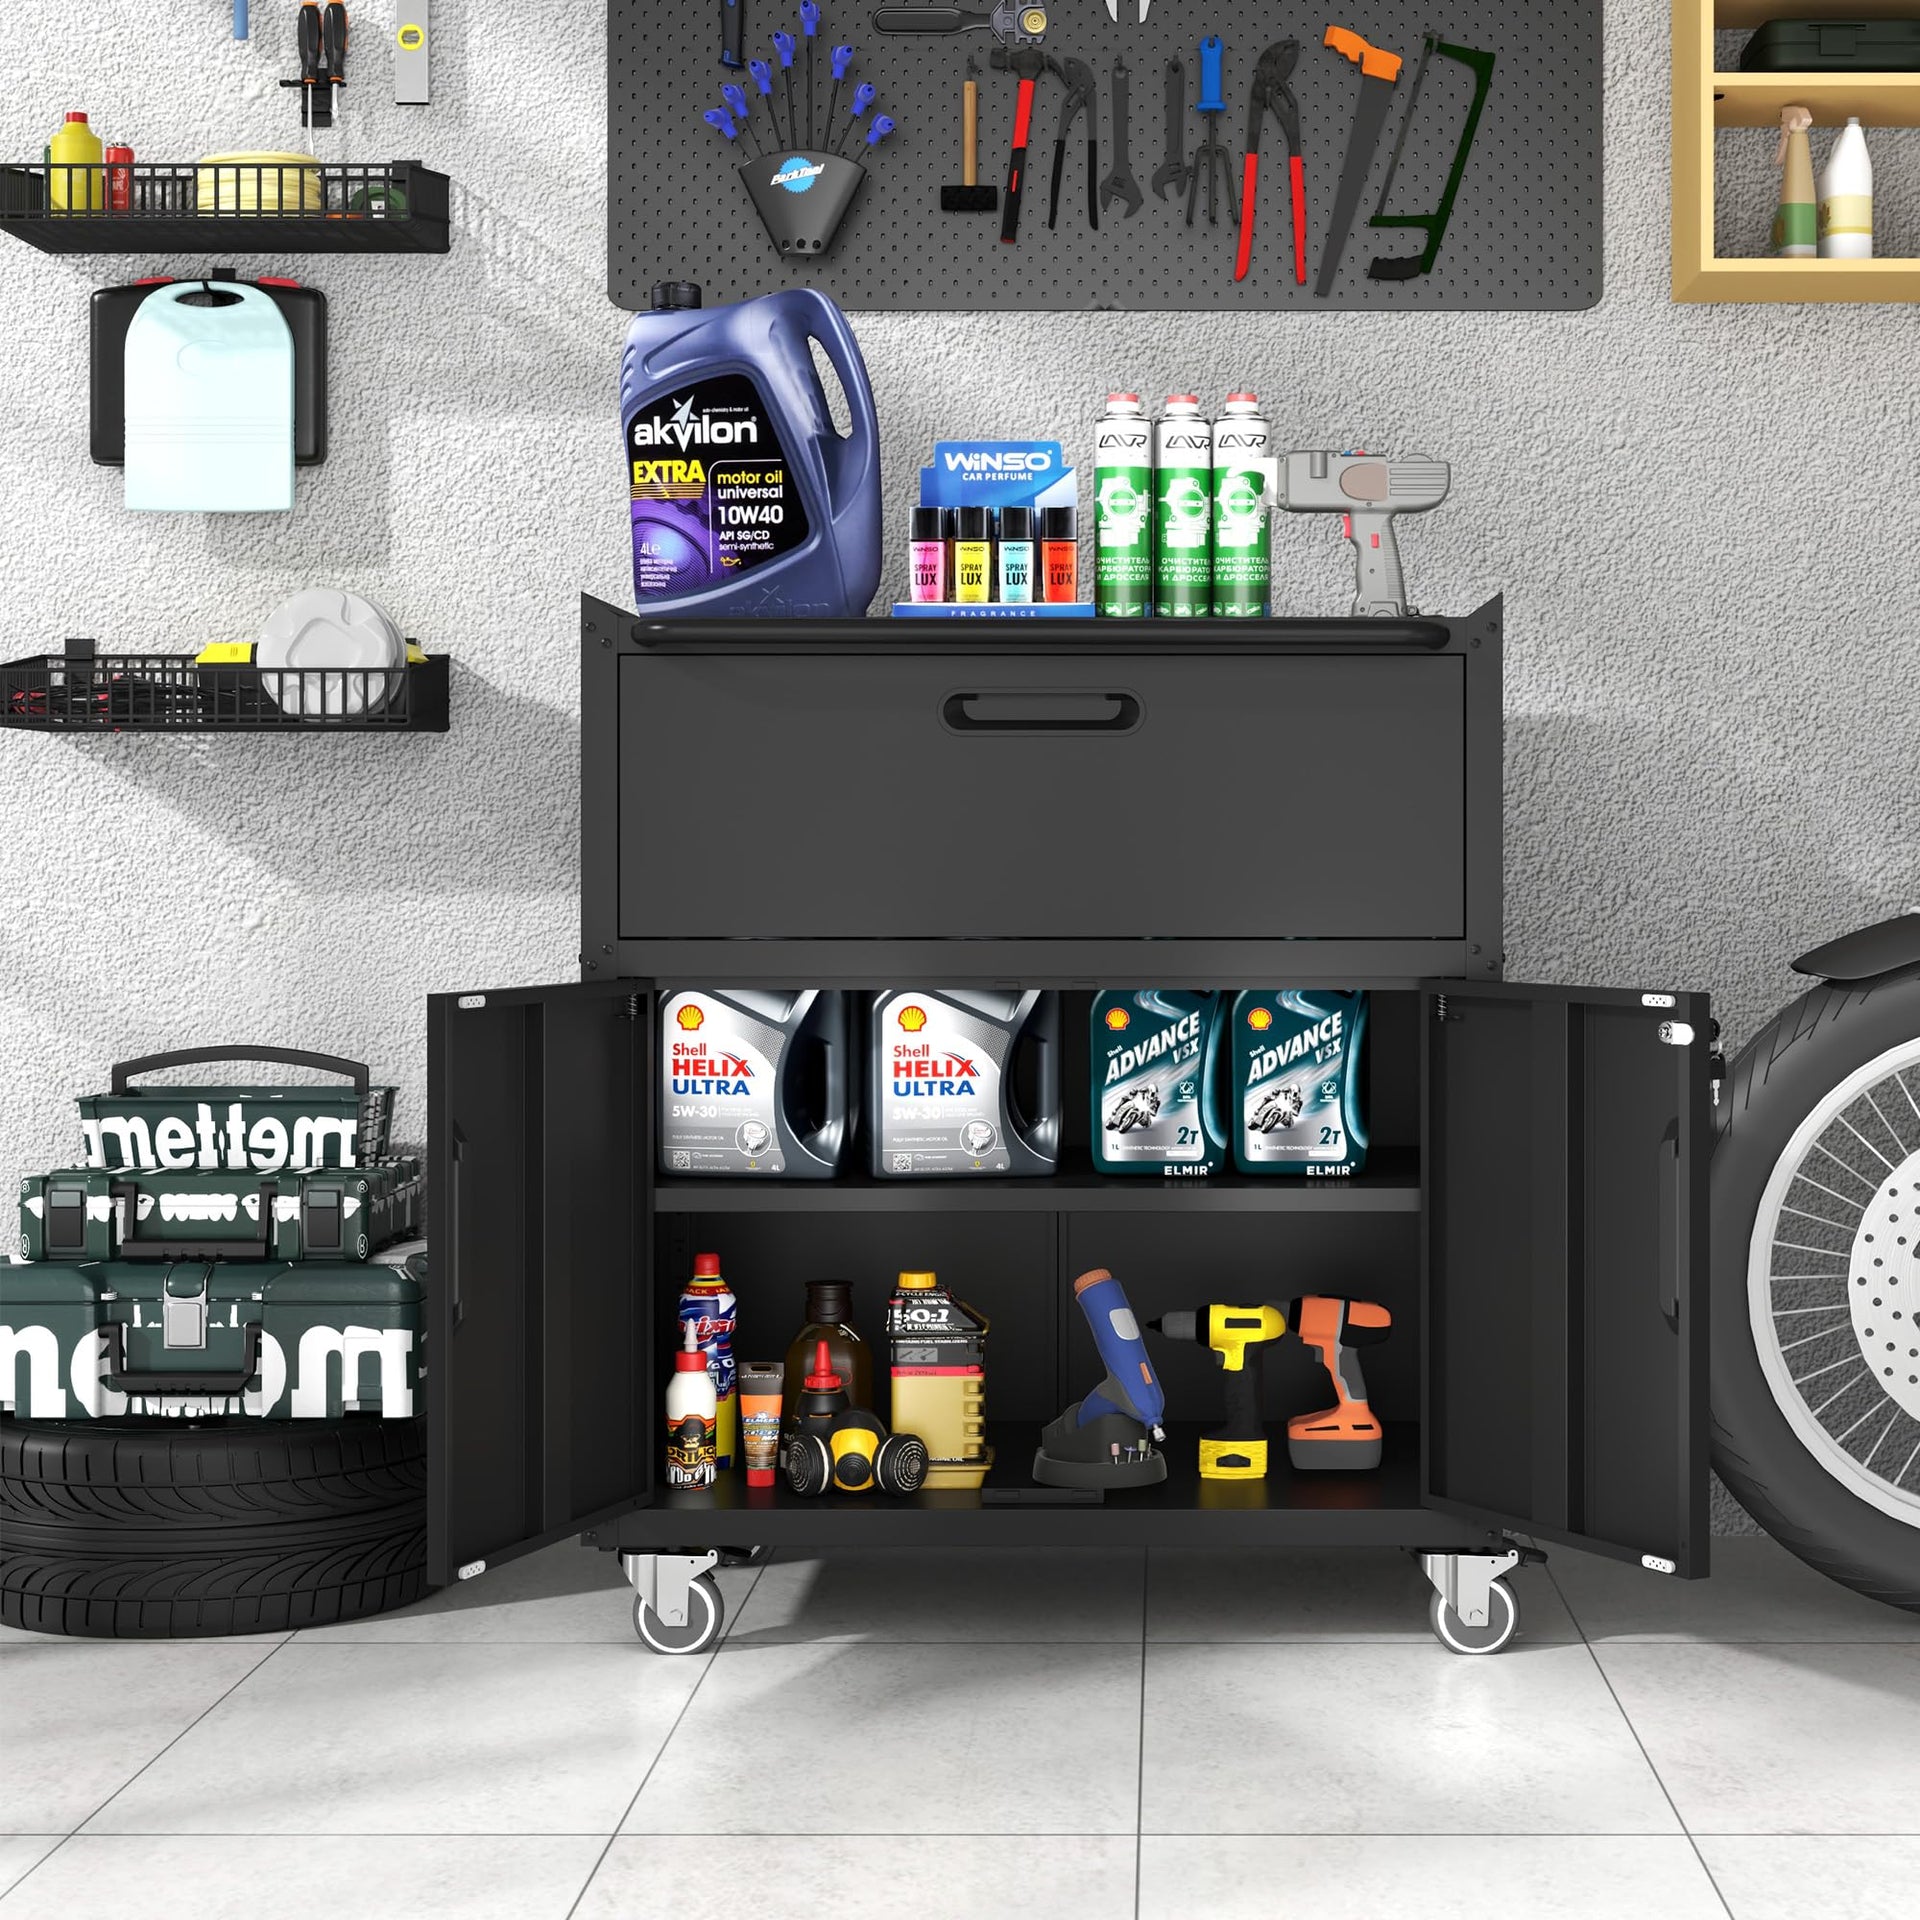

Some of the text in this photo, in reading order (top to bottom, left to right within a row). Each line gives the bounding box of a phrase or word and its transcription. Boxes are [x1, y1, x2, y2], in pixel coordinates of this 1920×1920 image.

[634, 415, 757, 452] akvilon
[633, 459, 706, 484] EXTRA
[717, 470, 783, 485] motor oil
[962, 472, 1033, 481] CAR PERFUME
[717, 485, 783, 499] universal
[718, 505, 784, 525] 10W40
[719, 530, 770, 541] API SG/CD
[915, 563, 937, 572] SPRAY
[961, 563, 982, 572] SPRAY
[1006, 563, 1028, 572] SPRAY
[1051, 563, 1073, 572] SPRAY
[915, 572, 937, 586] LUX
[961, 572, 982, 586] LUX
[1006, 572, 1028, 586] LUX
[1051, 572, 1073, 586] LUX
[672, 1043, 707, 1056] Shell
[893, 1045, 930, 1058] Shell
[1105, 1010, 1200, 1086] ADVANCE
[1173, 1037, 1199, 1064] VSX
[1247, 1010, 1343, 1086] ADVANCE
[1315, 1037, 1341, 1064] VSX
[672, 1052, 755, 1078] HELIX
[893, 1052, 980, 1078] HELIX
[672, 1080, 751, 1095] ULTRA
[893, 1080, 976, 1096] ULTRA
[672, 1105, 717, 1118] 5W-30
[1177, 1126, 1199, 1145] 2T
[1319, 1126, 1341, 1145] 2T
[1164, 1165, 1208, 1175] ELMIR
[1306, 1165, 1350, 1175] ELMIR
